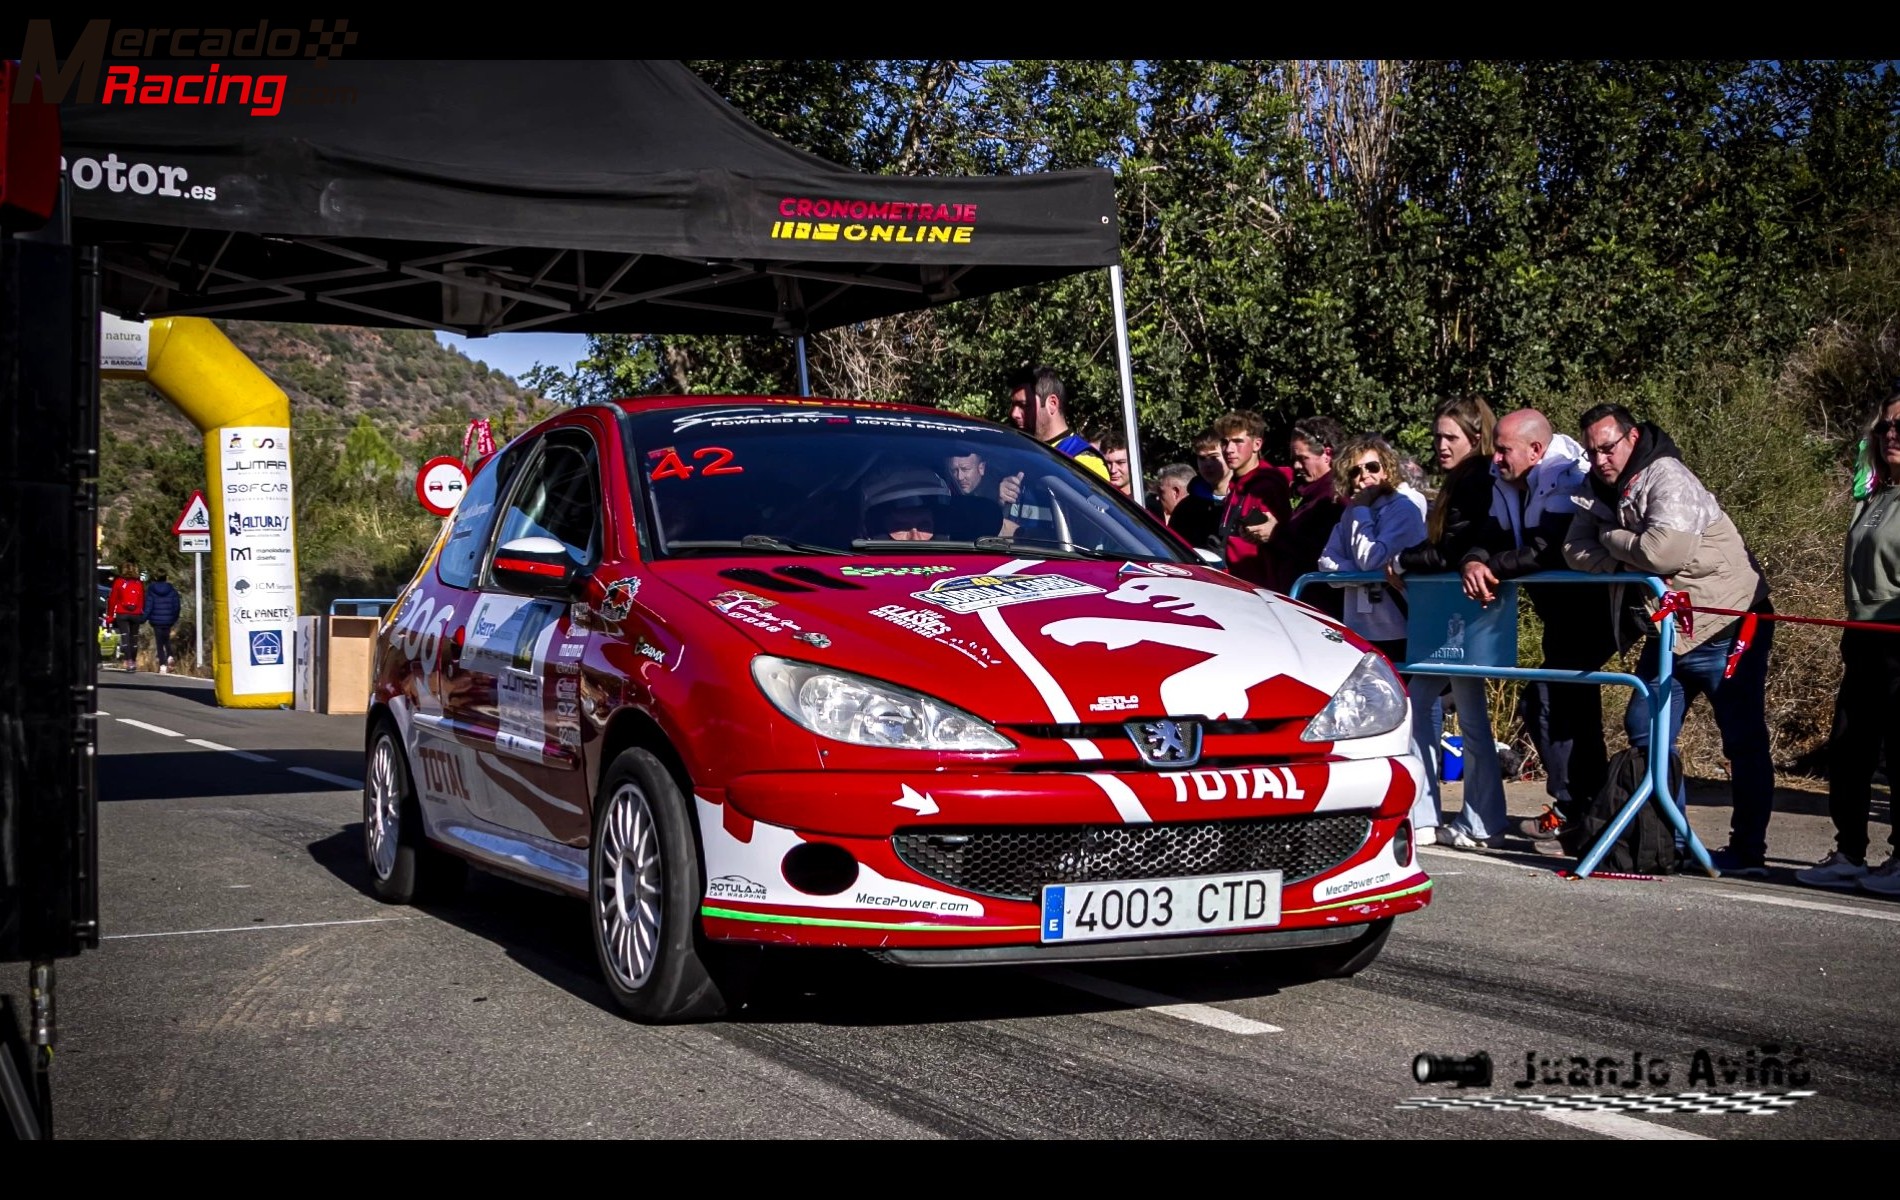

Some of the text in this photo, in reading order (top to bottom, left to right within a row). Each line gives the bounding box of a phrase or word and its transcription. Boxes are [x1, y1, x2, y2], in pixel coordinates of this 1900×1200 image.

[778, 198, 978, 222] CRONOMETRAJE
[843, 223, 974, 243] ONLINE
[106, 331, 142, 342] natura
[711, 417, 793, 427] POWERED
[856, 418, 912, 427] MOTOR
[916, 423, 967, 434] SPORT
[650, 447, 744, 480] 42
[227, 483, 288, 494] SOFCAR
[241, 608, 288, 619] EL PANETE
[390, 588, 454, 676] 206
[419, 746, 471, 800] TOTAL
[1158, 766, 1306, 802] TOTAL
[710, 883, 767, 894] ROTULA.ME
[1325, 872, 1391, 897] MecaPower.com
[728, 892, 767, 900] WRAPPING
[855, 892, 969, 912] MecaPower.com
[1074, 879, 1267, 932] 4003 CTD
[1048, 918, 1060, 932] E
